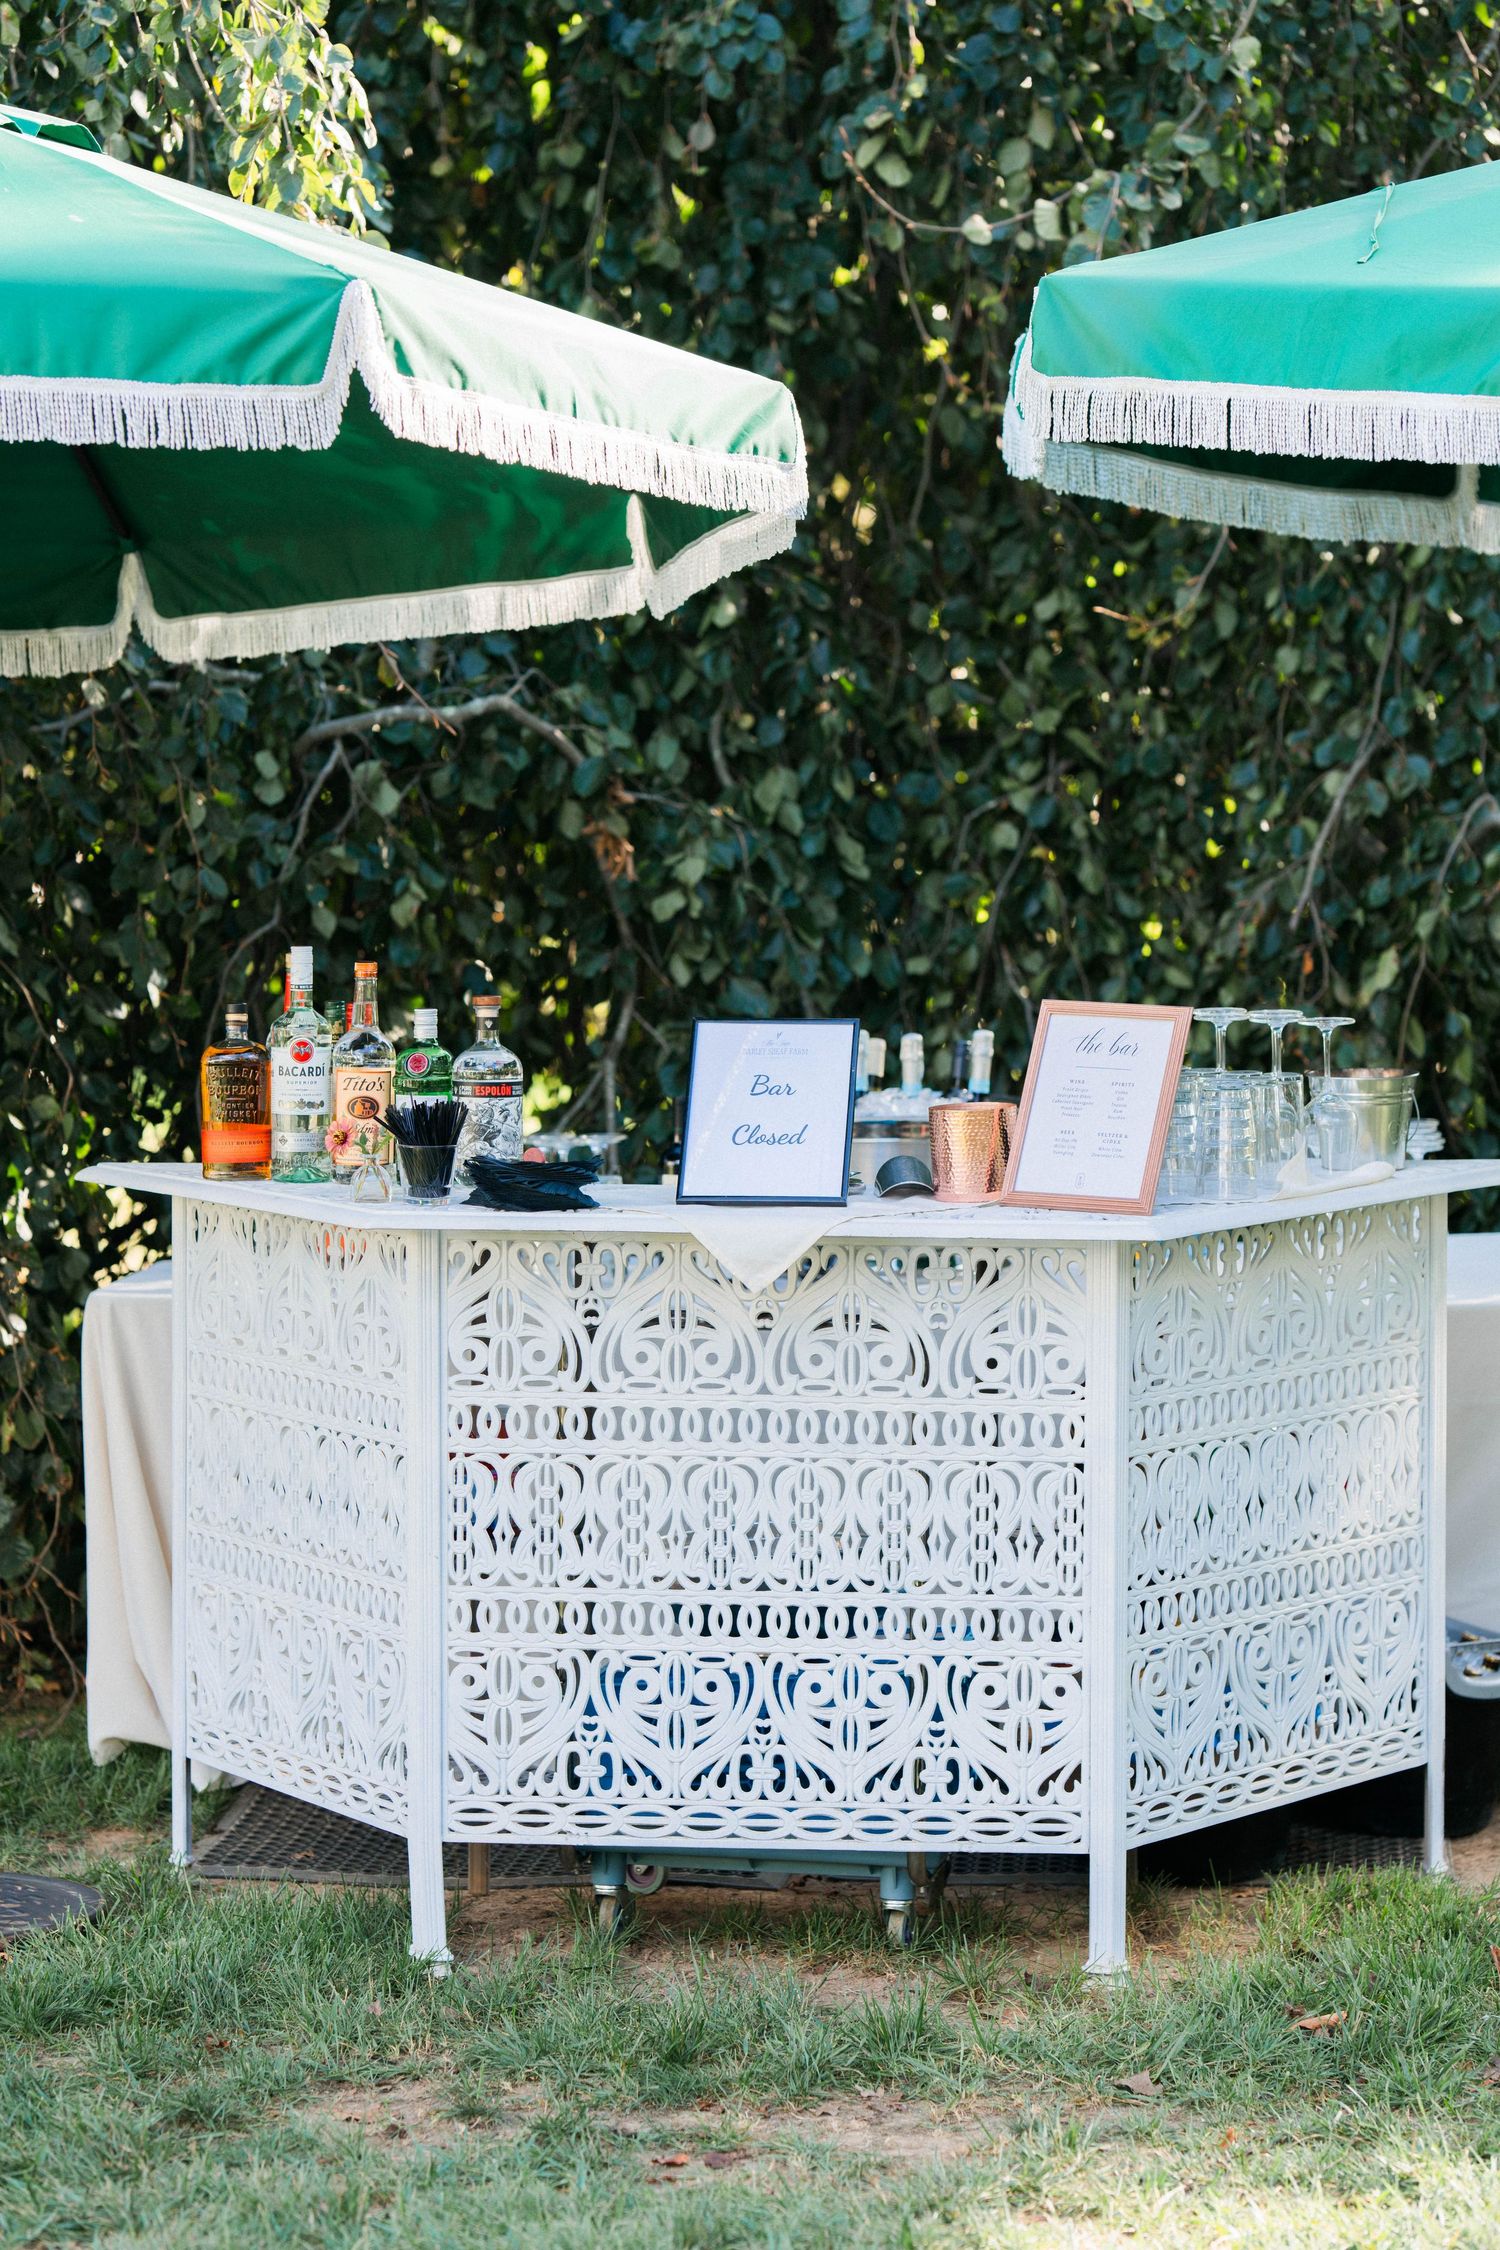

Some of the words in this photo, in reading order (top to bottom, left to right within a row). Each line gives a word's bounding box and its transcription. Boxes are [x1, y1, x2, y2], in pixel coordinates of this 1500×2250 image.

[1072, 1027, 1104, 1054] the
[1109, 1031, 1139, 1056] bar
[278, 1062, 325, 1077] BACARDÍ
[343, 1076, 385, 1092] Tito's
[475, 1084, 512, 1096] ESPOLÓN
[749, 1074, 797, 1096] Bar
[215, 1110, 258, 1118] WHISKEY
[731, 1124, 809, 1146] Closed
